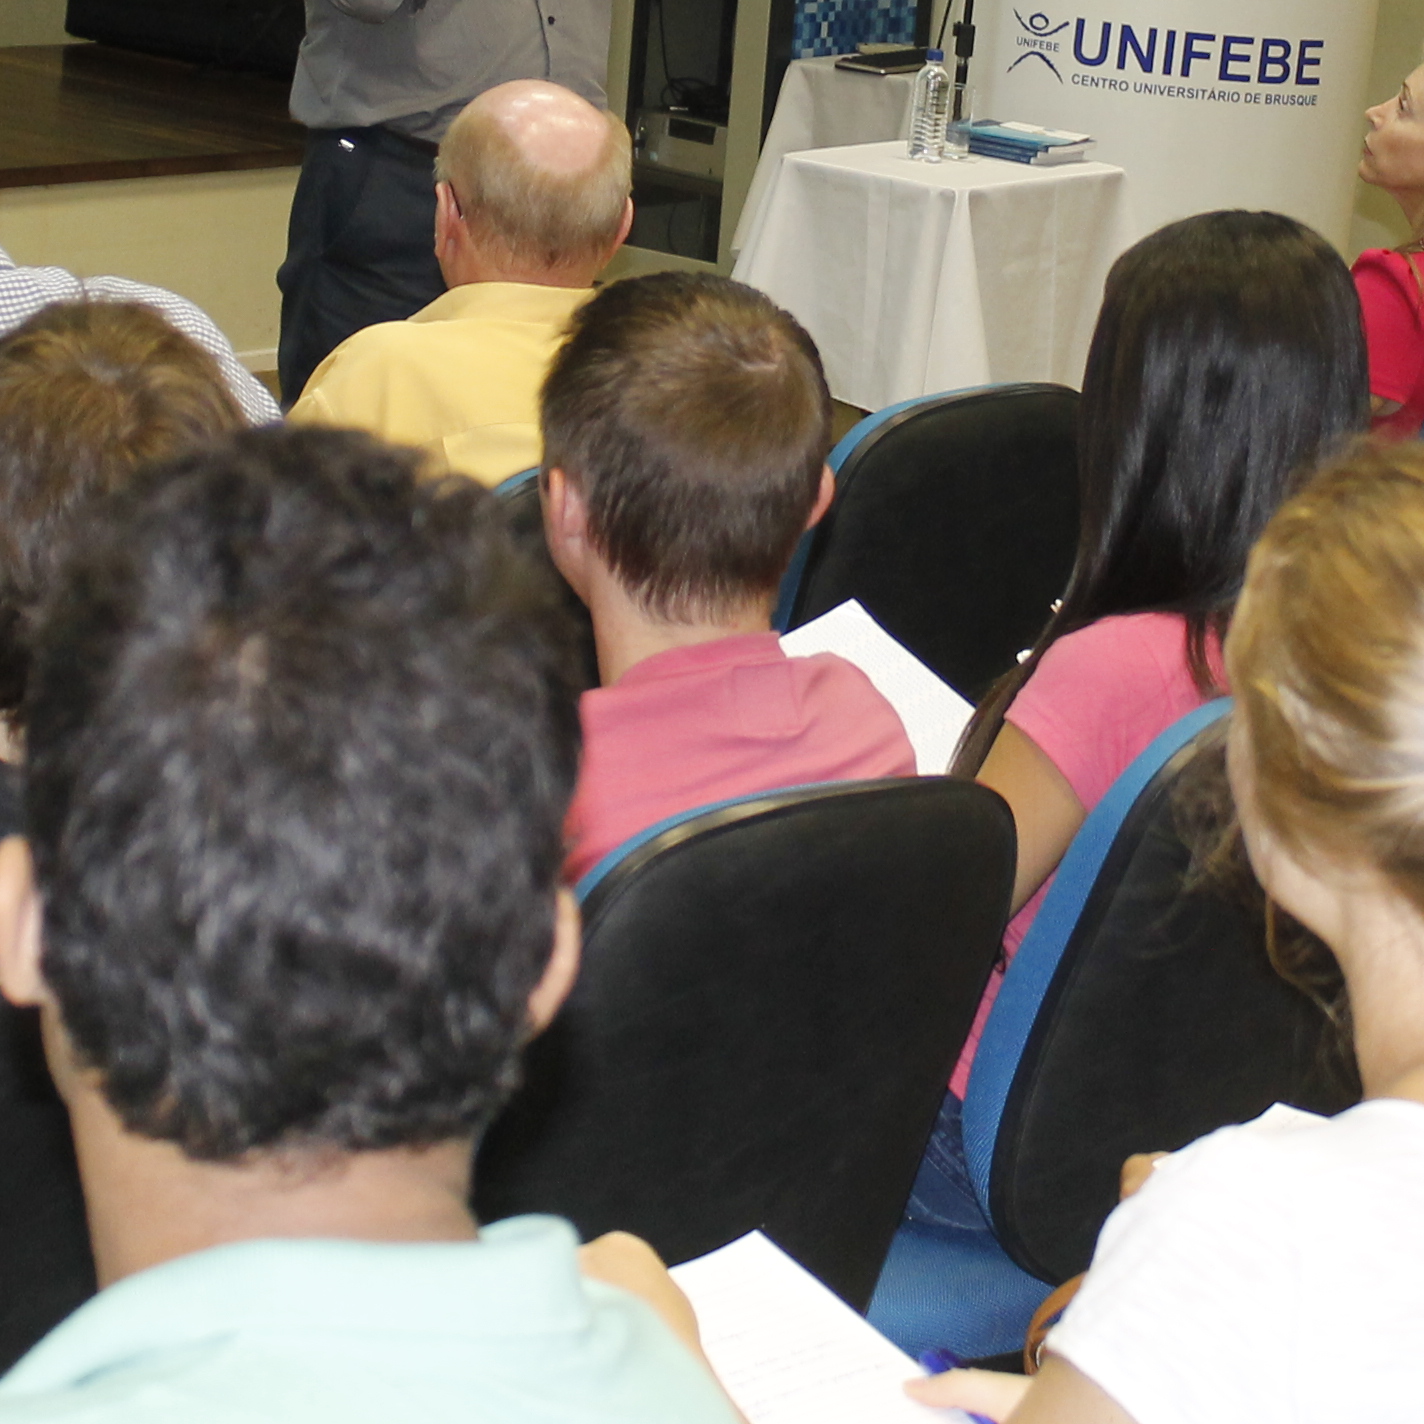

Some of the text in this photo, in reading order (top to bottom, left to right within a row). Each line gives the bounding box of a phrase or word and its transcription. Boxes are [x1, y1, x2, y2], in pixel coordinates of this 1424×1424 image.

[1016, 36, 1060, 53] UNIFEBE
[1072, 17, 1324, 86] UNIFEBE
[1071, 73, 1317, 107] CENTRO UNIVERSITÁRIO DE BRUSQUE
